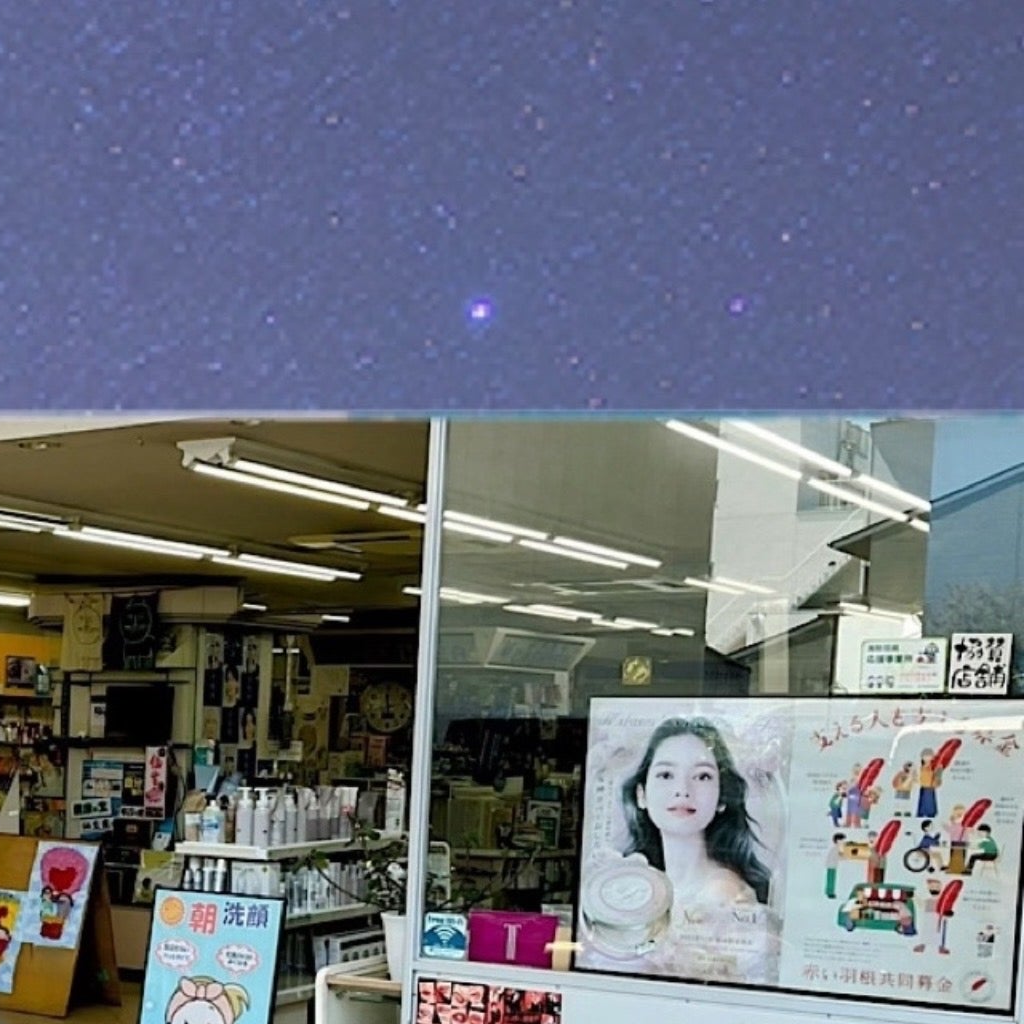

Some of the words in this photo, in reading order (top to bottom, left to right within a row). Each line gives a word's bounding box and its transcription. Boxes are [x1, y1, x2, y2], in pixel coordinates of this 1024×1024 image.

[188, 902, 218, 935] 朝
[222, 901, 269, 929] 洗顔
[803, 964, 953, 993] 赤い羽根共同募金
